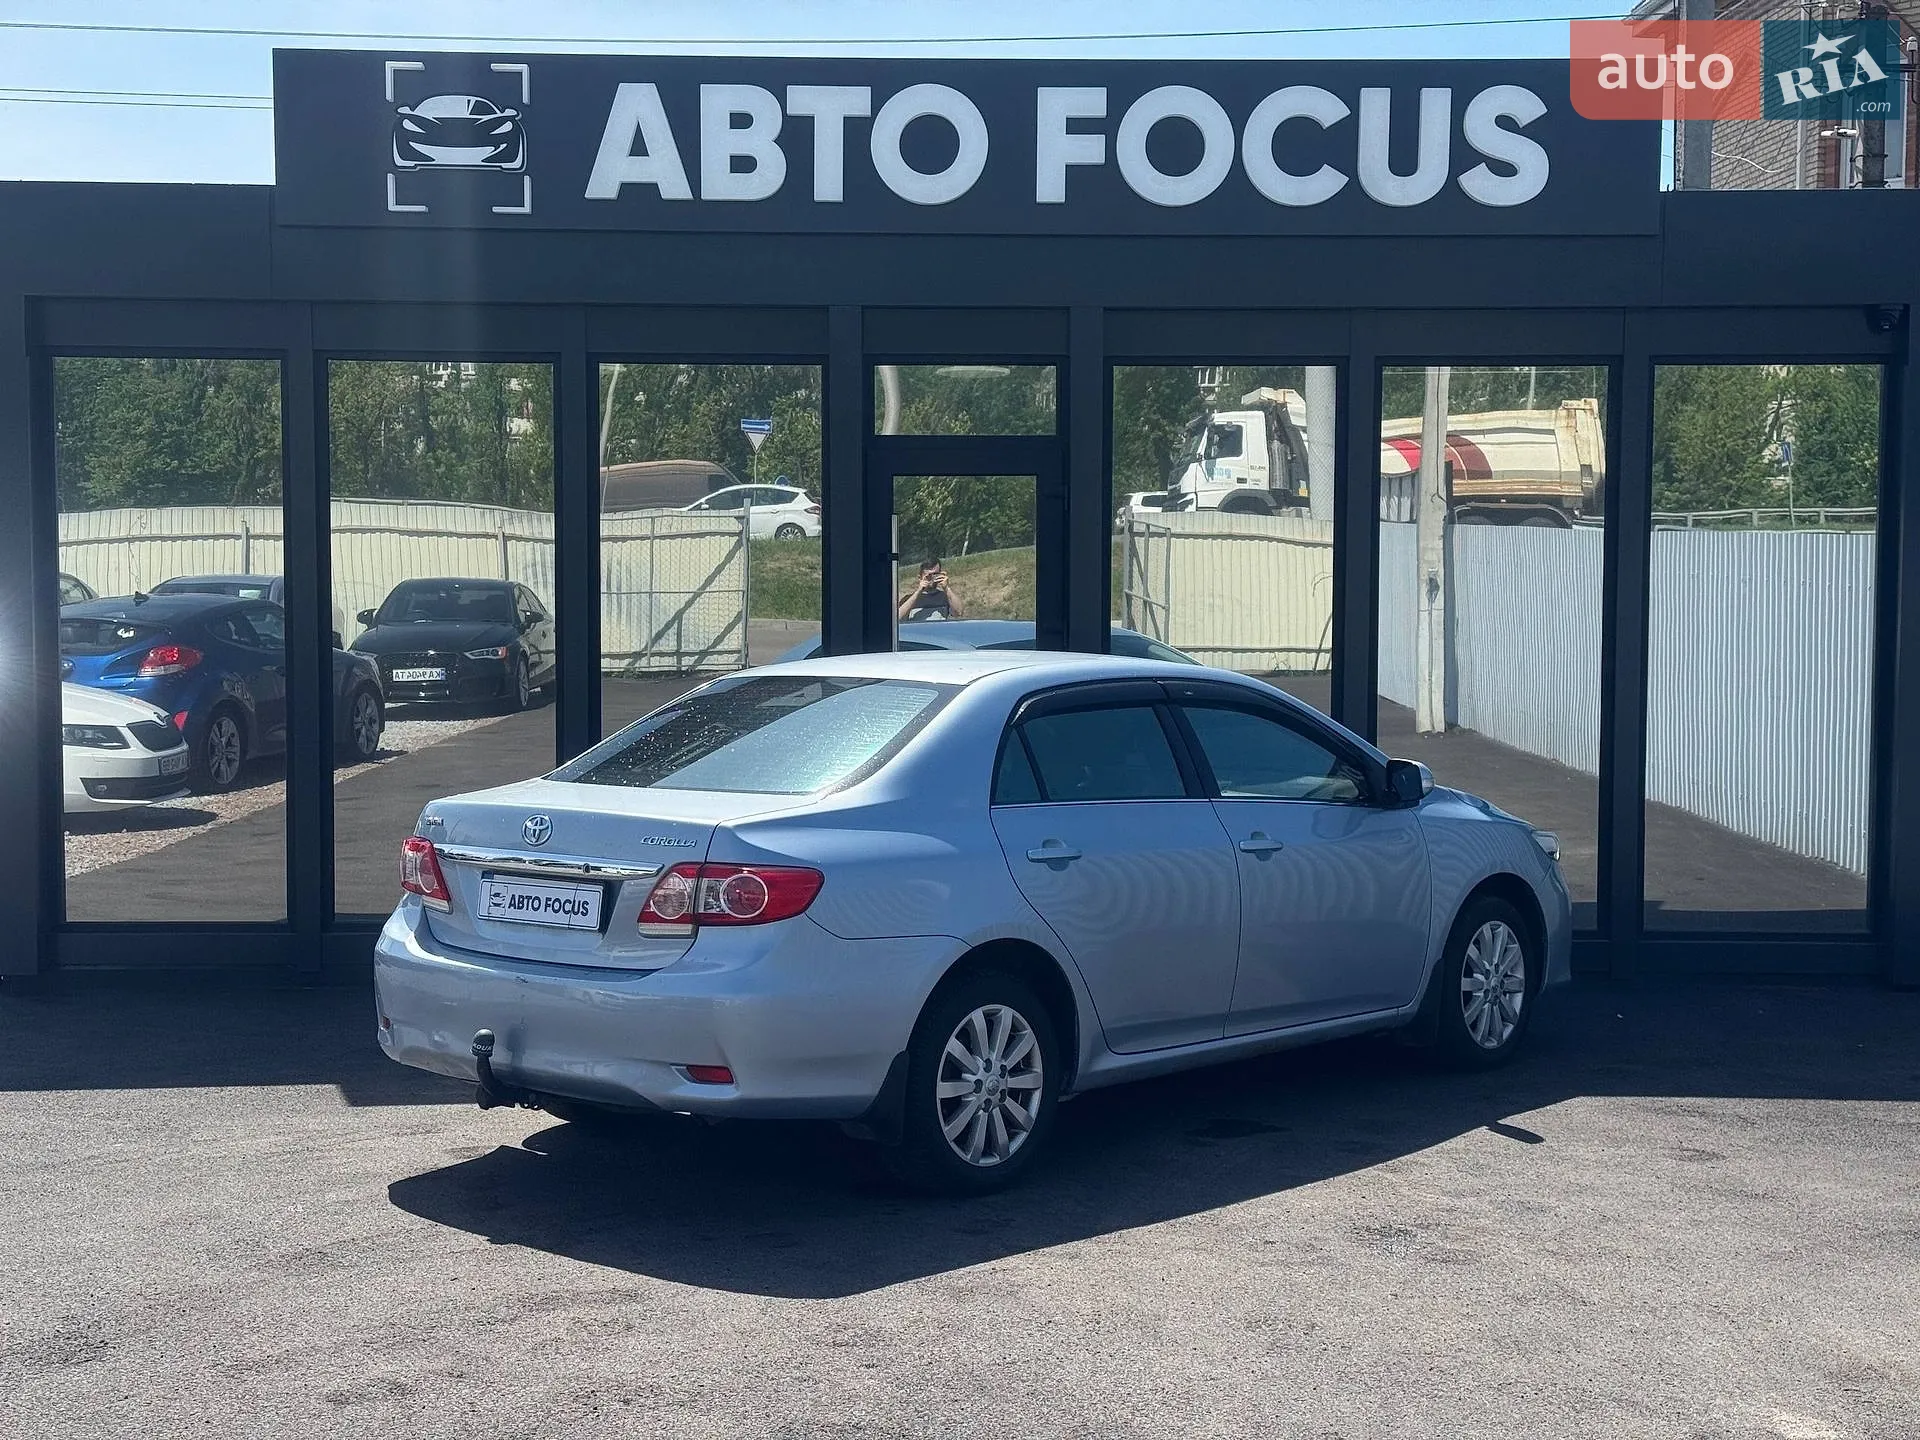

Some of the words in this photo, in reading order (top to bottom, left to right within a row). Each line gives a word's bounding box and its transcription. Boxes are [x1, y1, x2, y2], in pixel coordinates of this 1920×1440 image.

[585, 83, 989, 205] АВТО
[1036, 85, 1550, 207] FOCUS
[641, 836, 697, 848] COROLLA
[544, 897, 589, 916] FOCUS
